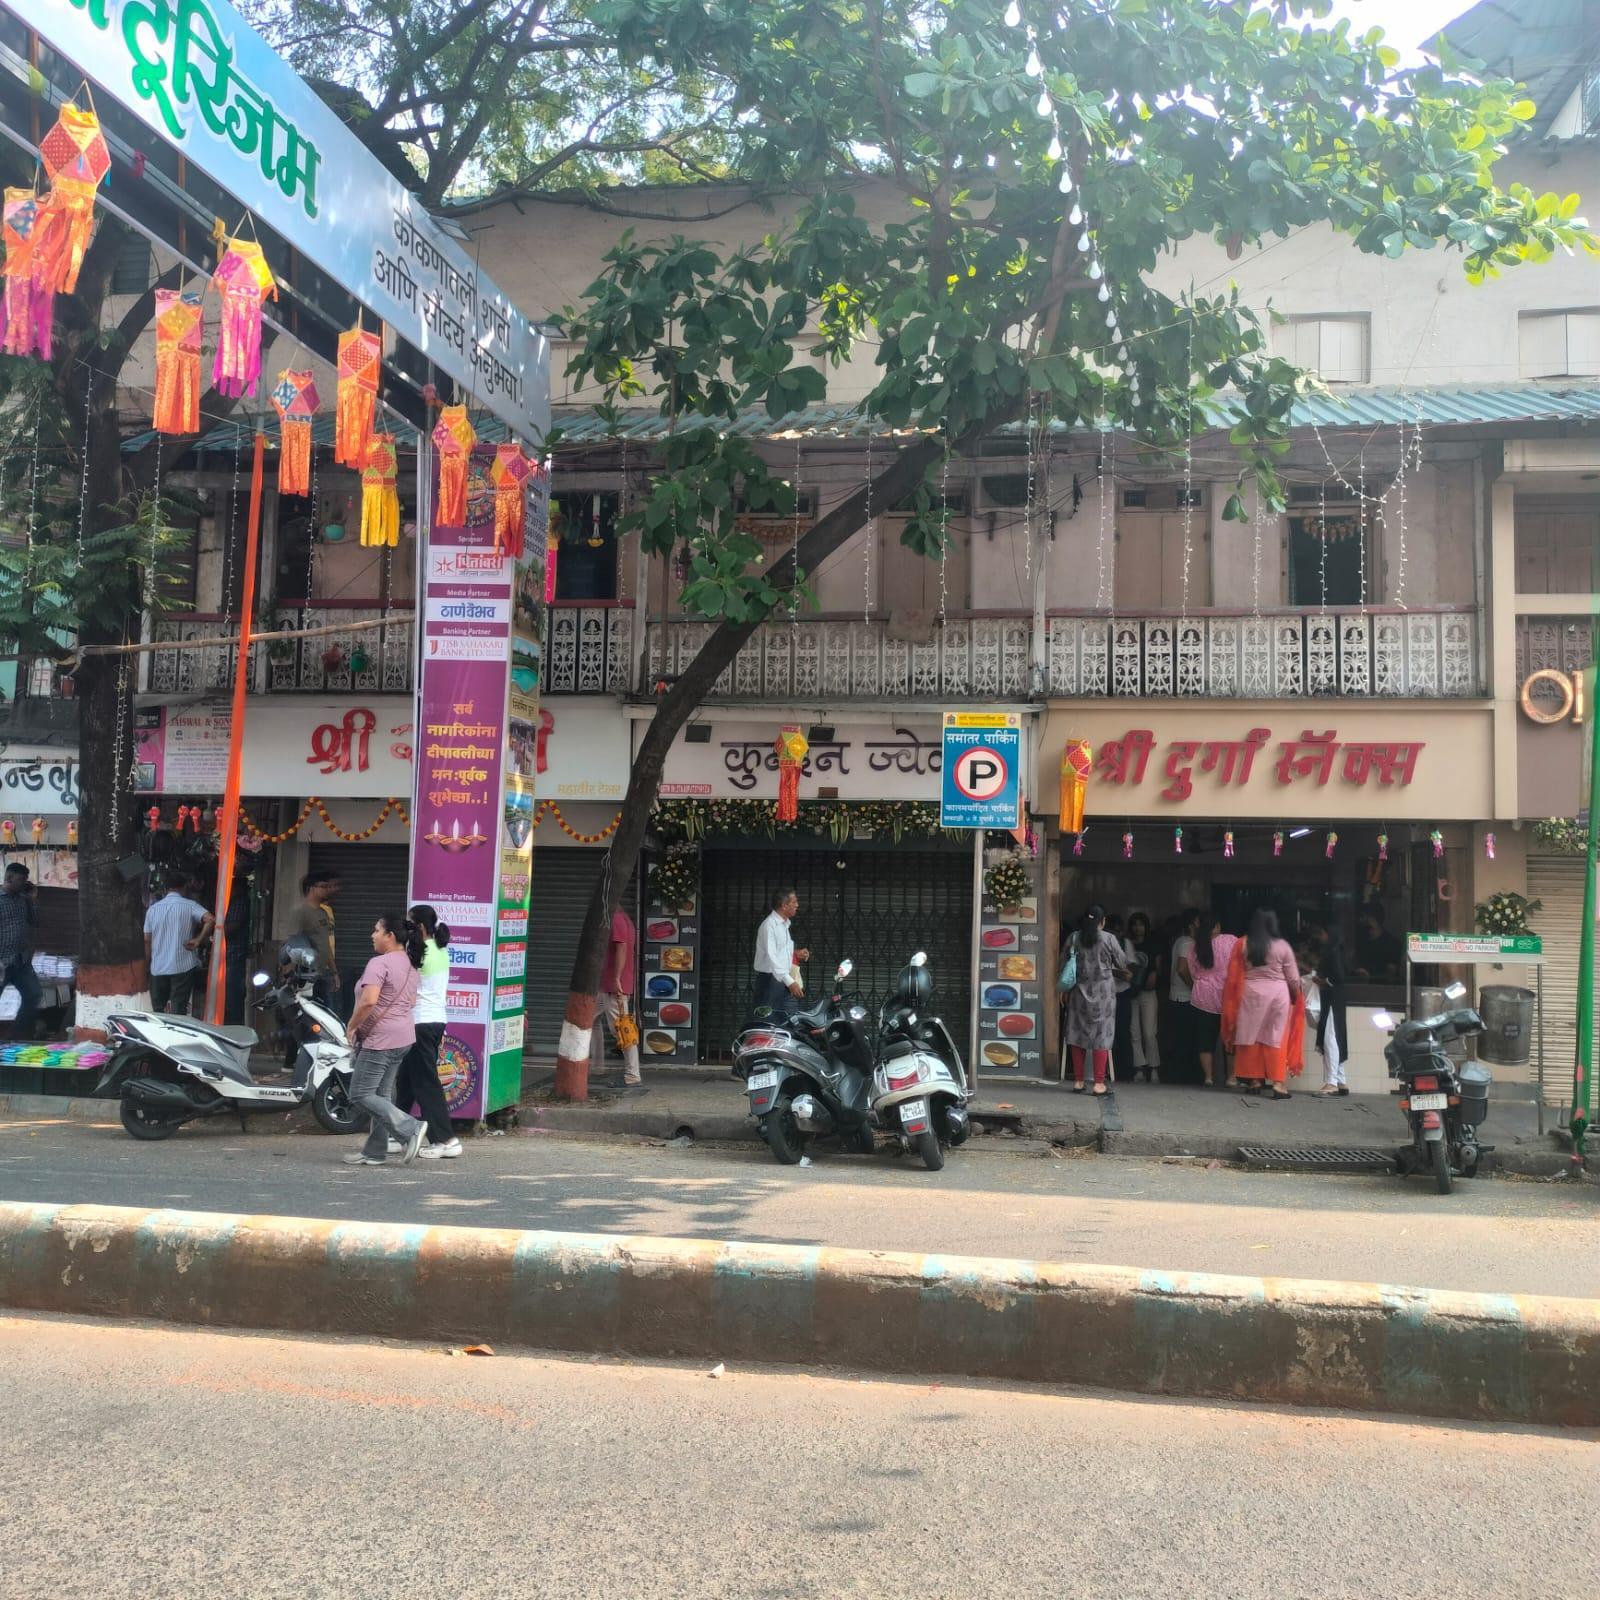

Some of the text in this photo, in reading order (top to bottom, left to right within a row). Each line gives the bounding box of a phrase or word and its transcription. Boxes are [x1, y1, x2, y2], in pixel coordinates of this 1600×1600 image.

[374, 249, 418, 314] आणि
[423, 288, 465, 356] सौंदर्य
[447, 589, 491, 597] Media Partner
[443, 627, 491, 636] Banking Partner
[460, 640, 503, 649] SAHAKARI
[453, 700, 474, 715] सर्व
[426, 721, 497, 737] नागरिकांना
[946, 729, 1018, 745] समांतर पार्किंग
[306, 708, 377, 775] श्री
[426, 743, 496, 759] दीपावलीच्या
[1095, 730, 1157, 786] श्री
[1160, 728, 1272, 801] दुर्गा
[969, 760, 998, 789] P
[447, 991, 478, 1008] तांबरी
[258, 1090, 292, 1098] SUZUKI
